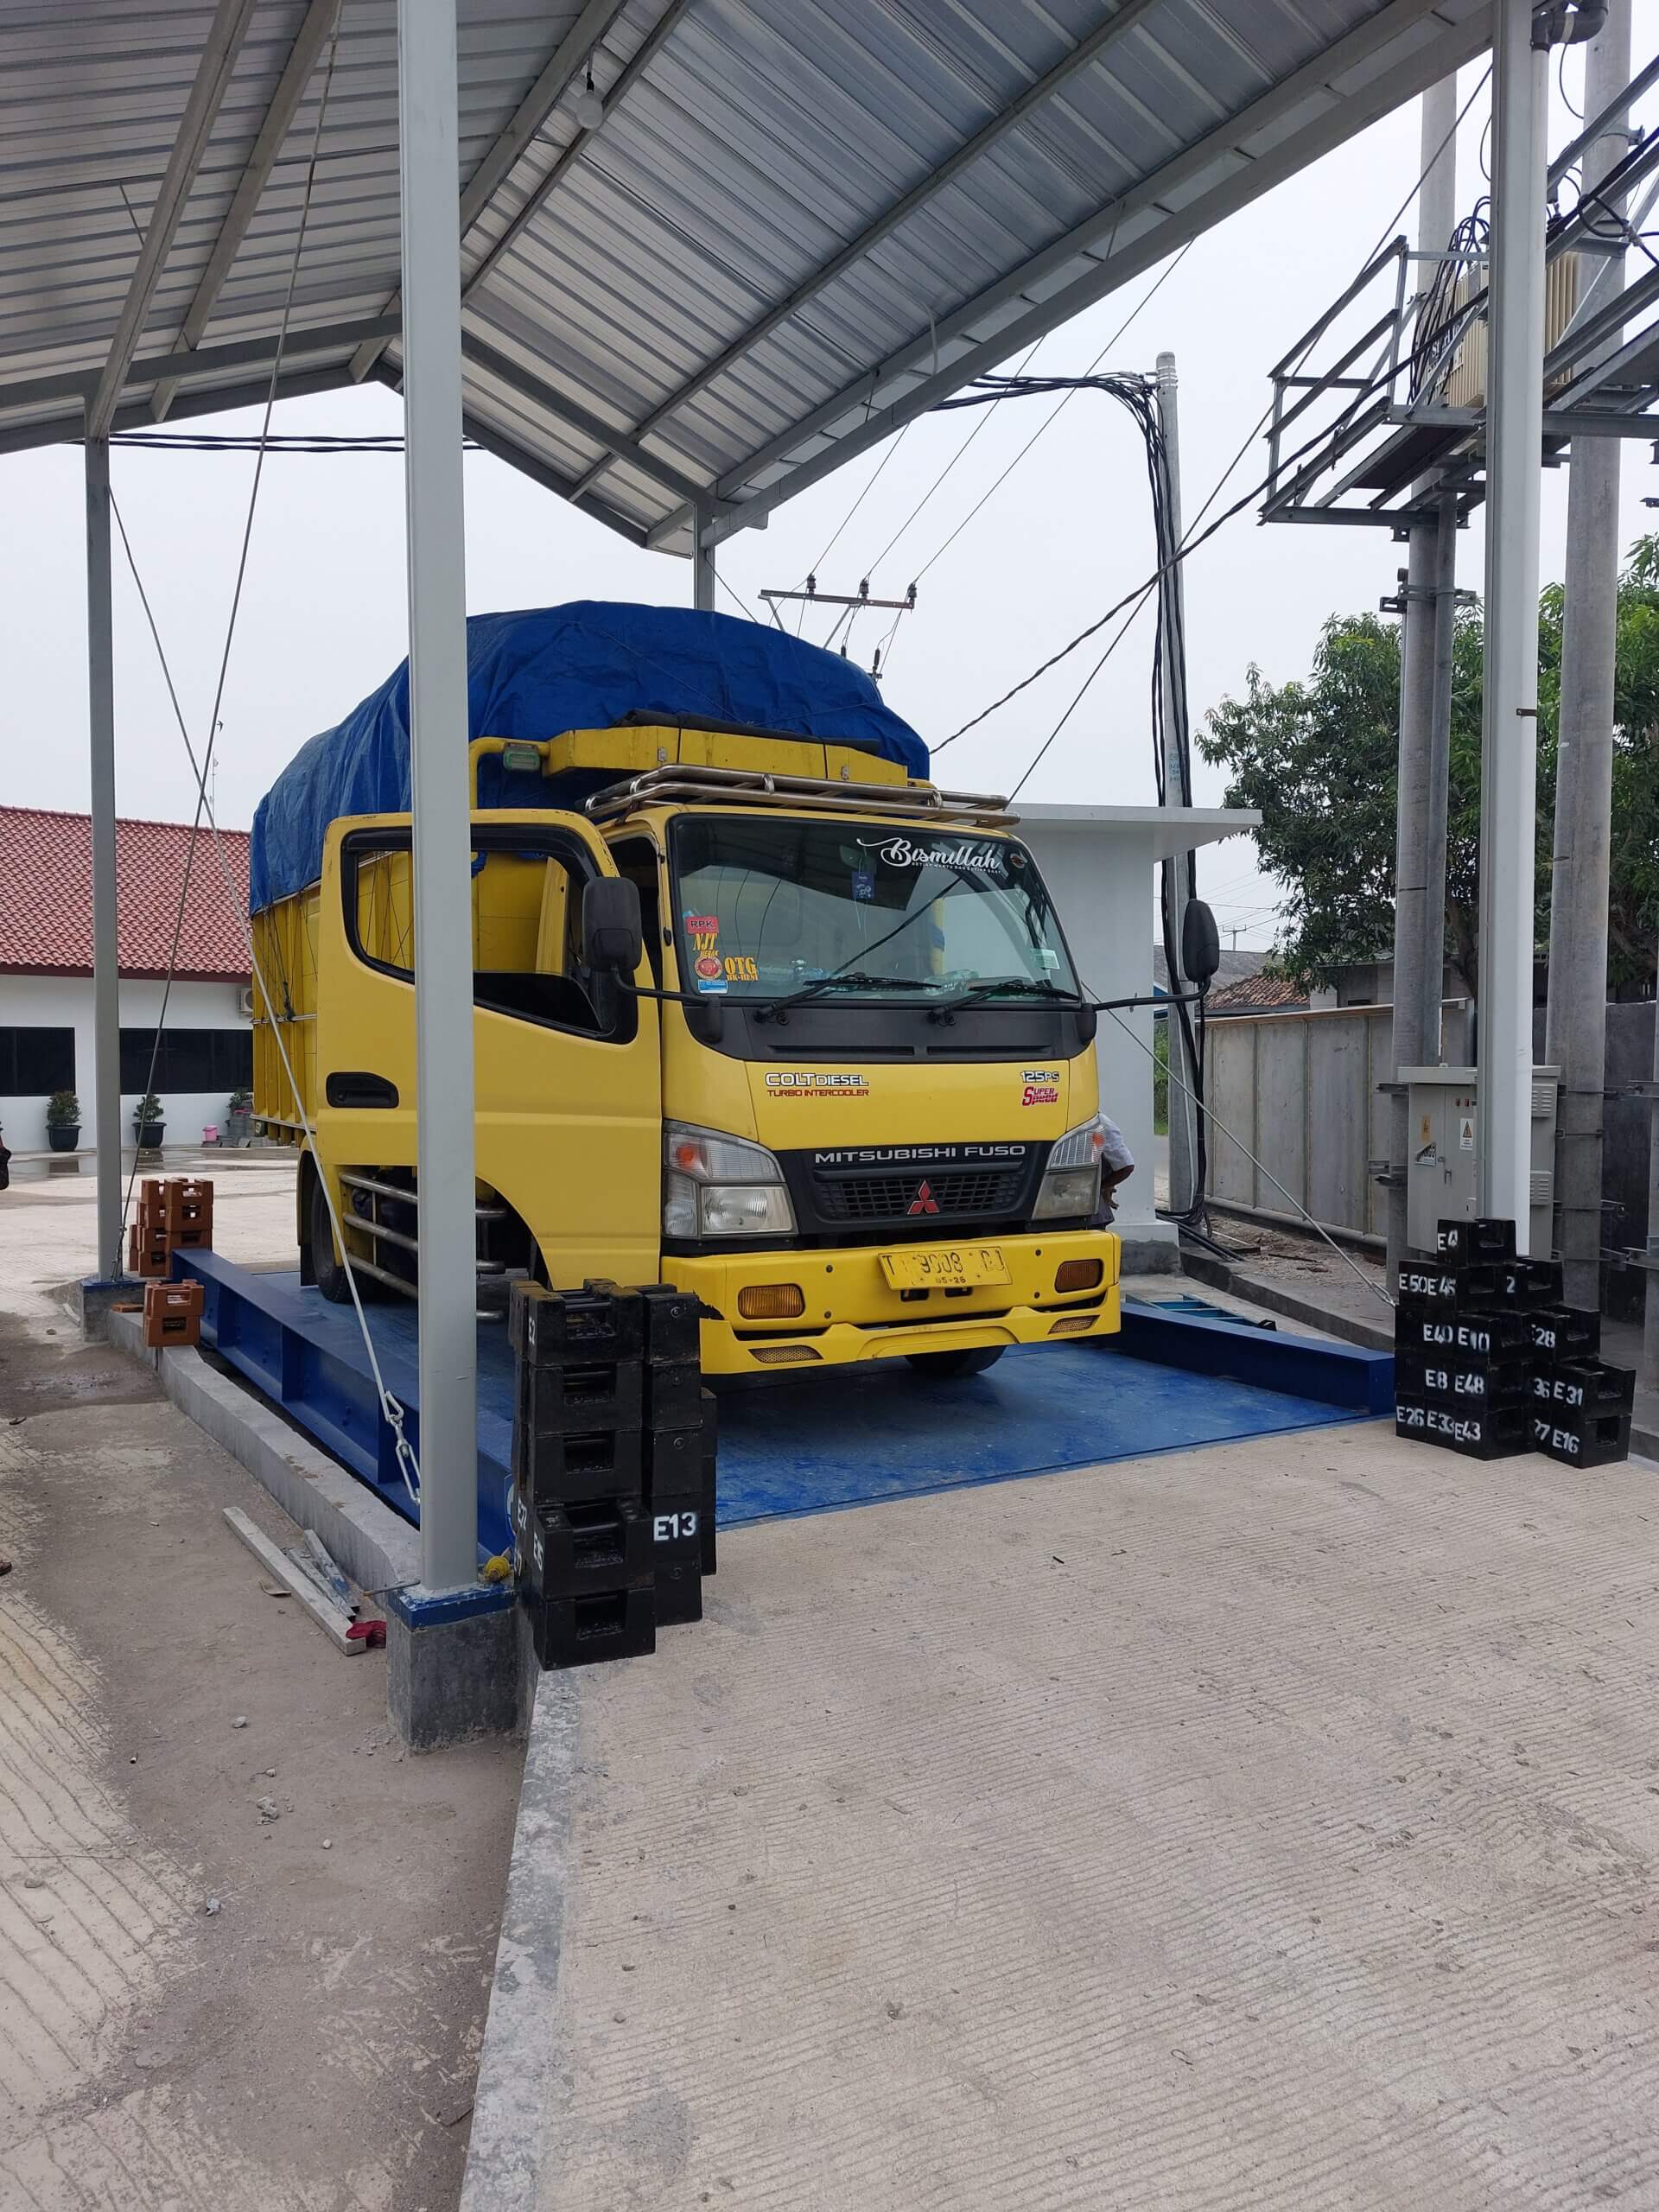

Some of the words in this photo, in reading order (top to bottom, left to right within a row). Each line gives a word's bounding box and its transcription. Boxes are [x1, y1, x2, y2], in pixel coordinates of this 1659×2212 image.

[724, 957, 757, 975] OTG
[765, 1072, 816, 1086] COLT
[815, 1074, 869, 1086] DIESEL
[1020, 1070, 1059, 1083] 125PS
[815, 1147, 957, 1163] MITSUBISHI
[964, 1146, 1026, 1156] FUSO
[1423, 1324, 1453, 1344] E40
[1425, 1369, 1448, 1390] E8
[1453, 1373, 1485, 1395] E48
[1554, 1380, 1583, 1406] E31
[1396, 1405, 1425, 1427] E26
[1453, 1420, 1482, 1442] E43
[1552, 1428, 1580, 1453] E16
[653, 1511, 697, 1542] E13
